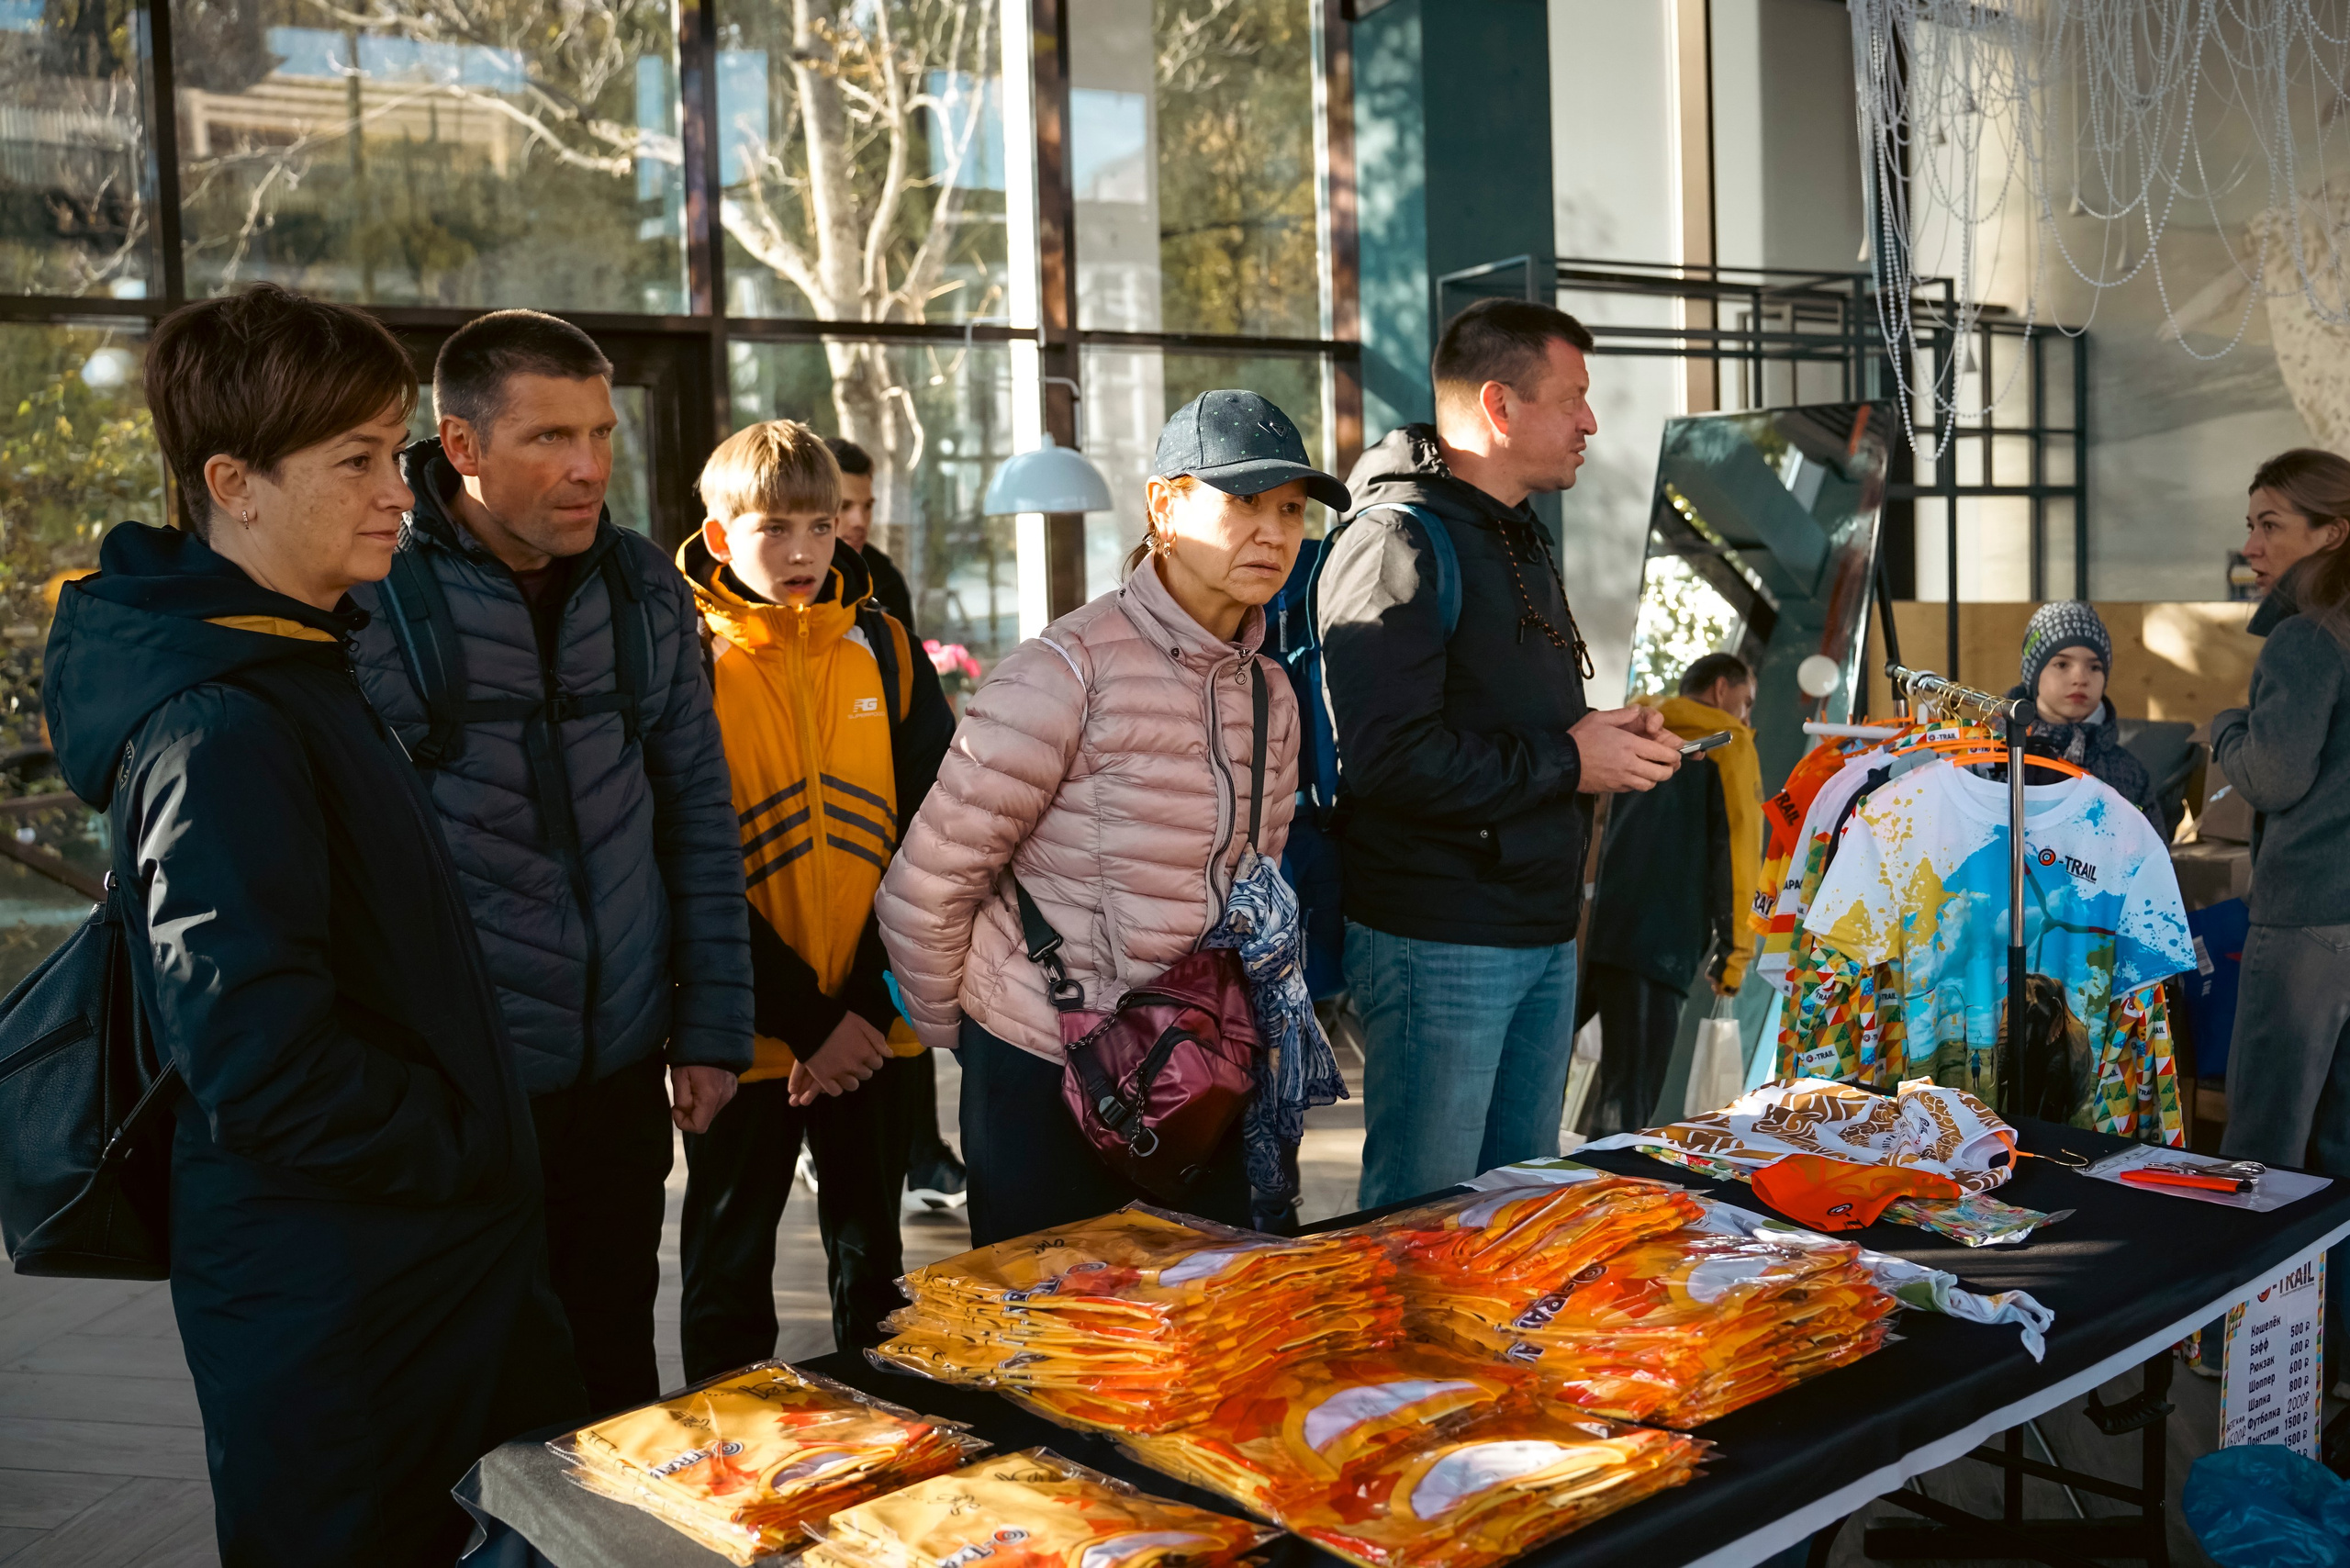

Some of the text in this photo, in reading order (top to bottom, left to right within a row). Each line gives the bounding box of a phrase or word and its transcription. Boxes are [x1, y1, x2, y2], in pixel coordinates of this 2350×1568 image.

[2251, 1315, 2281, 1338] Кошелёк
[2290, 1322, 2303, 1338] 500
[2250, 1338, 2269, 1357] Бафф
[2289, 1340, 2303, 1356] 600
[2249, 1355, 2275, 1375] Рюкзак
[2289, 1359, 2302, 1374] 600
[2248, 1373, 2276, 1394] Шоппер
[2288, 1376, 2302, 1393] 800
[2248, 1394, 2271, 1412] Шапка
[2247, 1407, 2281, 1431] Футболка
[2284, 1413, 2301, 1430] 1500
[2284, 1430, 2301, 1448] 1500
